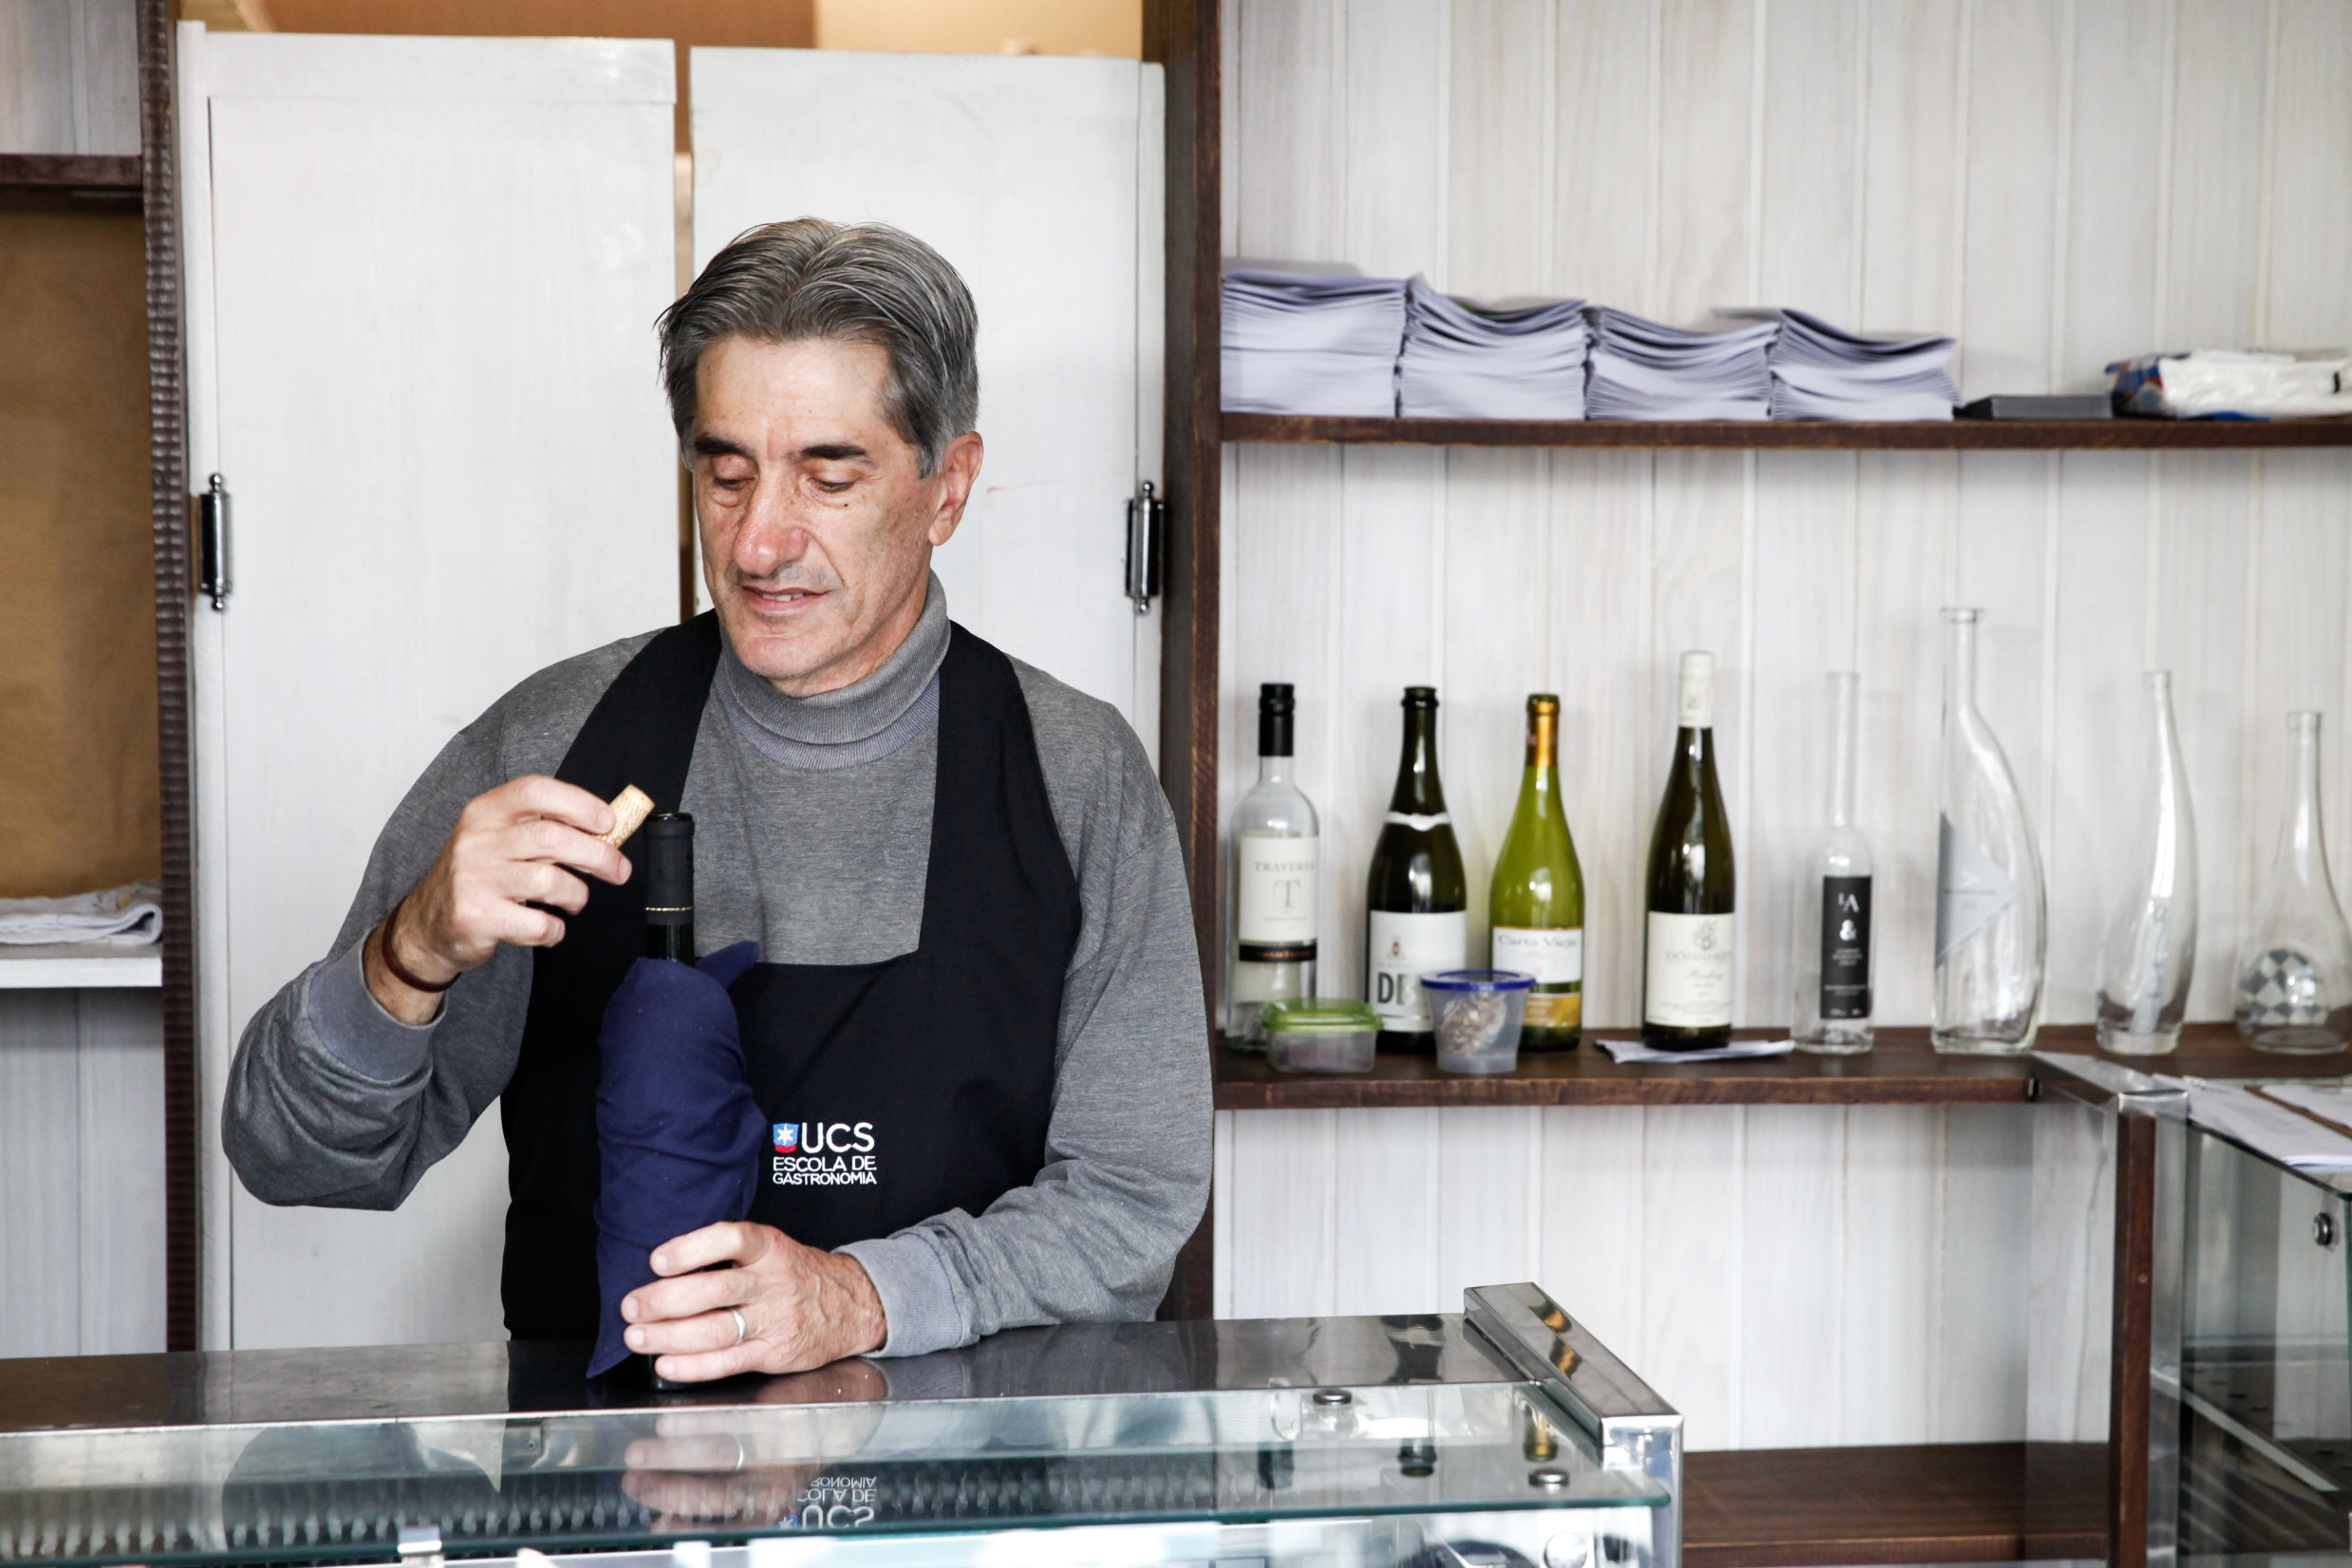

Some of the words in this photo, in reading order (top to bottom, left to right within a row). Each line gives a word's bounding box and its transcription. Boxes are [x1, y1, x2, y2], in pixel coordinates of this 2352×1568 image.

[1274, 879, 1301, 908] T
[1498, 934, 1538, 946] Carta
[801, 1122, 875, 1154] UCS
[773, 1156, 848, 1172] ESCOLA
[851, 1155, 877, 1171] DE
[772, 1171, 877, 1185] GASTRONOMIA
